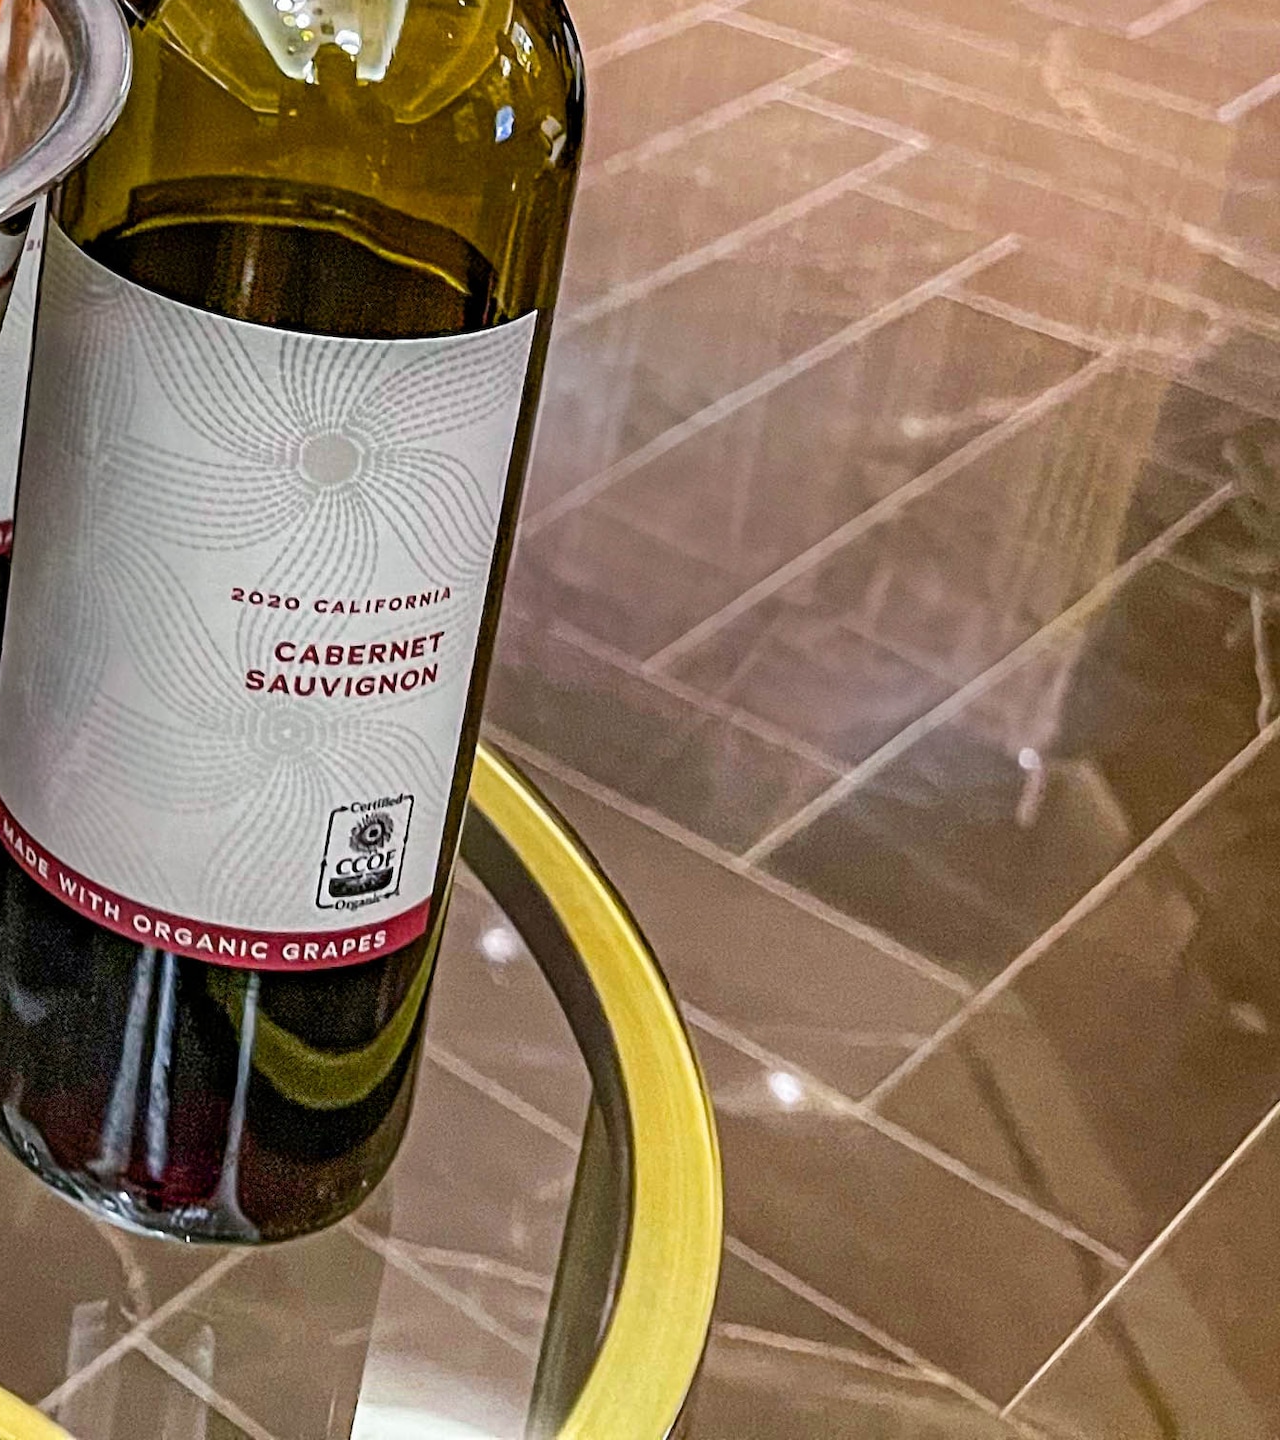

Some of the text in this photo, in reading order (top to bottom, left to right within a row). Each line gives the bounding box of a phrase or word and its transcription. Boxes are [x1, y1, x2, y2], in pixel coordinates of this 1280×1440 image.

[231, 586, 451, 614] 2020 CALIFORNIA
[274, 631, 445, 666] CABERNET
[245, 663, 438, 698] SAUVIGNON
[335, 848, 397, 876] CCOF
[2, 818, 387, 962] MADE WITH ORGANIC GRAPES
